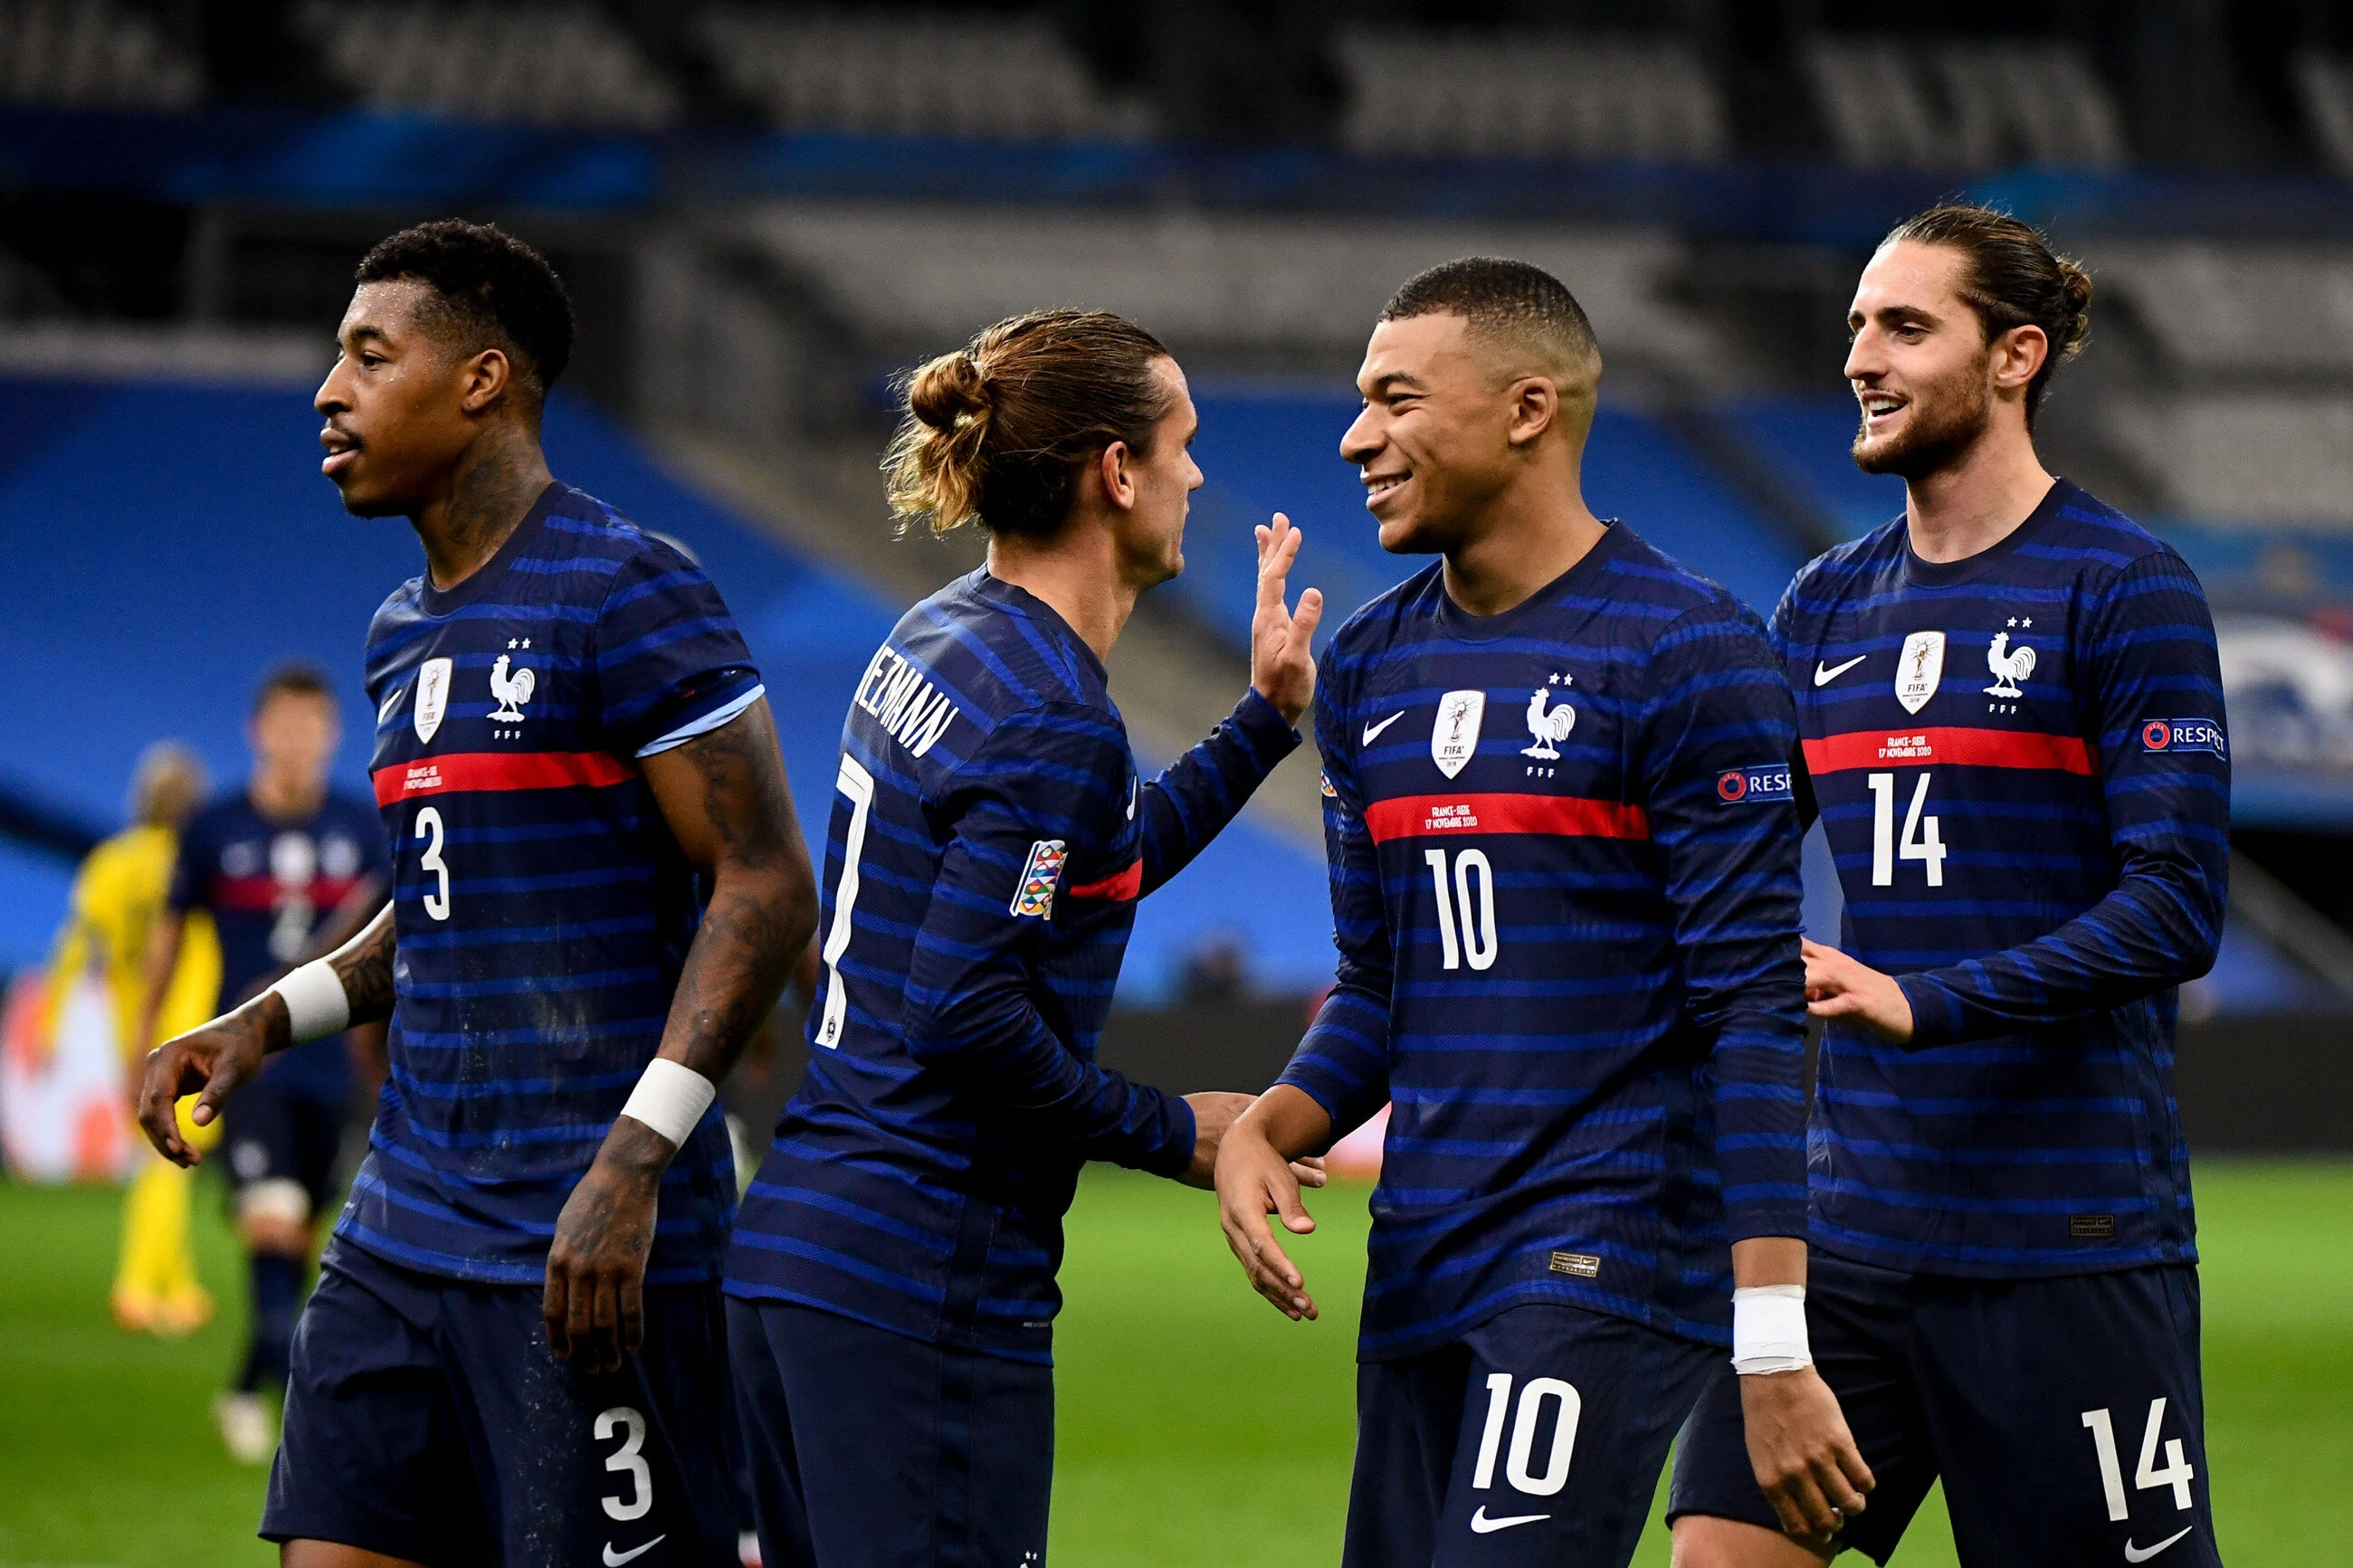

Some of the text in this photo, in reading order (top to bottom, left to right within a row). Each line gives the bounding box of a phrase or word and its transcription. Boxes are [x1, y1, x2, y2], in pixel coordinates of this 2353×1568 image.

[1907, 683, 1928, 692] FIFA
[1443, 746, 1464, 755] FIFA
[1878, 746, 1932, 758] 17 NOVEMBRE 2020
[414, 806, 451, 922] 3
[1425, 816, 1478, 830] 17 NOVEMBRE 2020
[1867, 772, 1948, 887] 14
[814, 752, 873, 1050] 7
[1424, 848, 1498, 971] 10
[594, 1406, 653, 1521] 3
[1472, 1373, 1582, 1497] 10
[2081, 1397, 2195, 1522] 14
